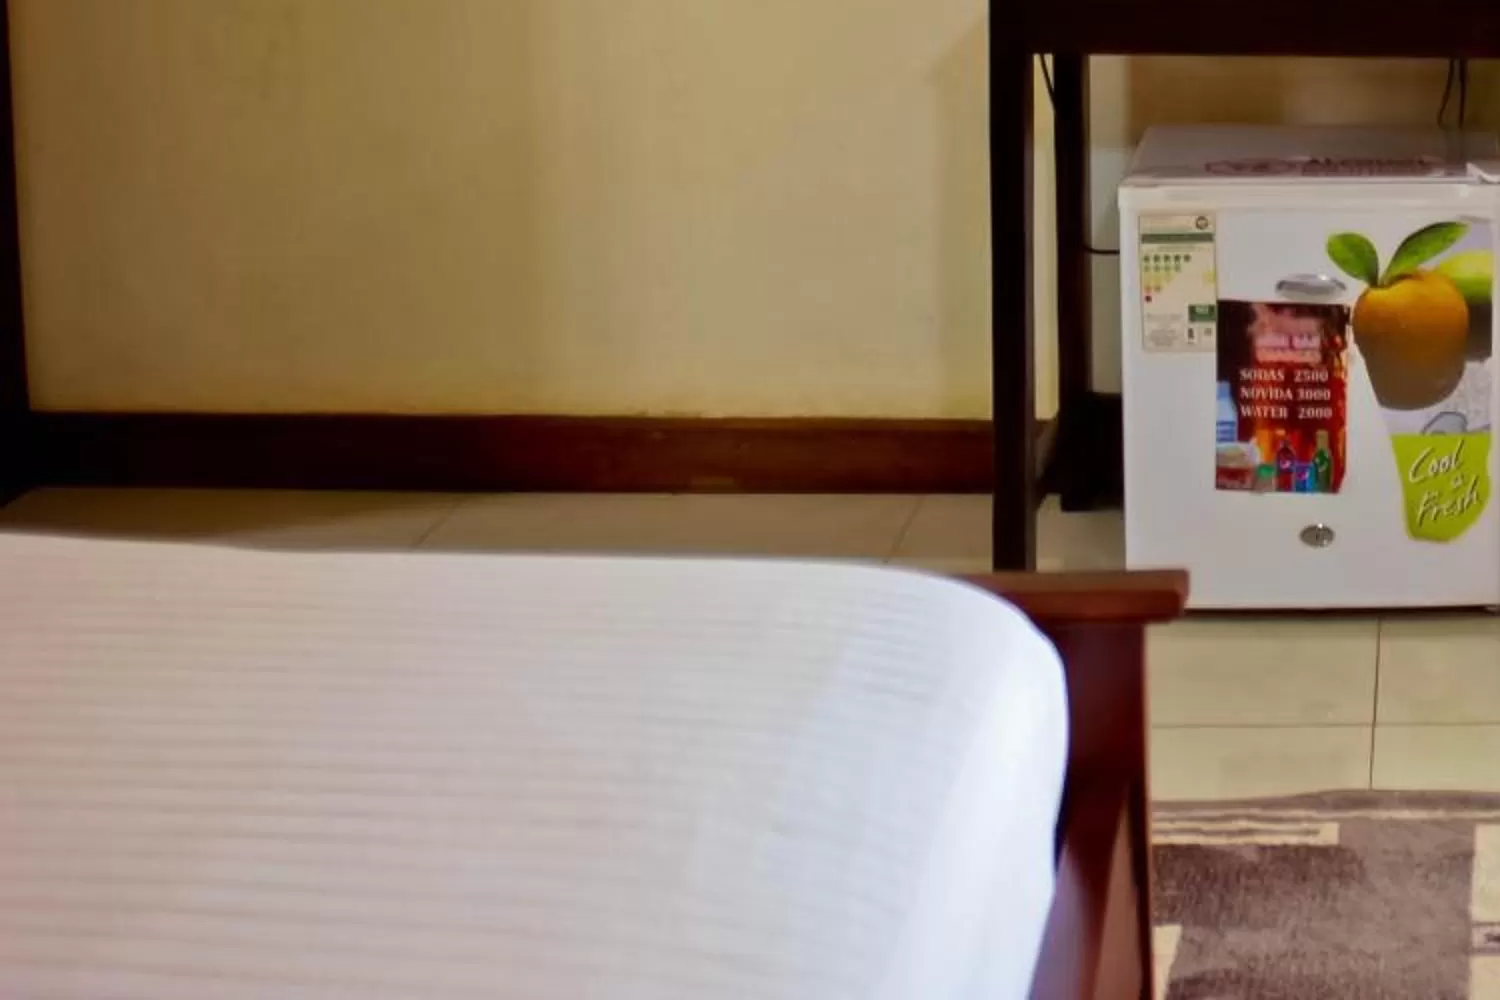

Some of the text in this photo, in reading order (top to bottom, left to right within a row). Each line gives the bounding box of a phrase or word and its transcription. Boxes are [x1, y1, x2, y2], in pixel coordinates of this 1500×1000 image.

[1240, 368, 1329, 383] SODAS 2500
[1297, 387, 1331, 401] 3000
[1240, 404, 1333, 419] WATER 2000
[1409, 438, 1465, 483] Cool
[1417, 474, 1483, 528] Fresh
